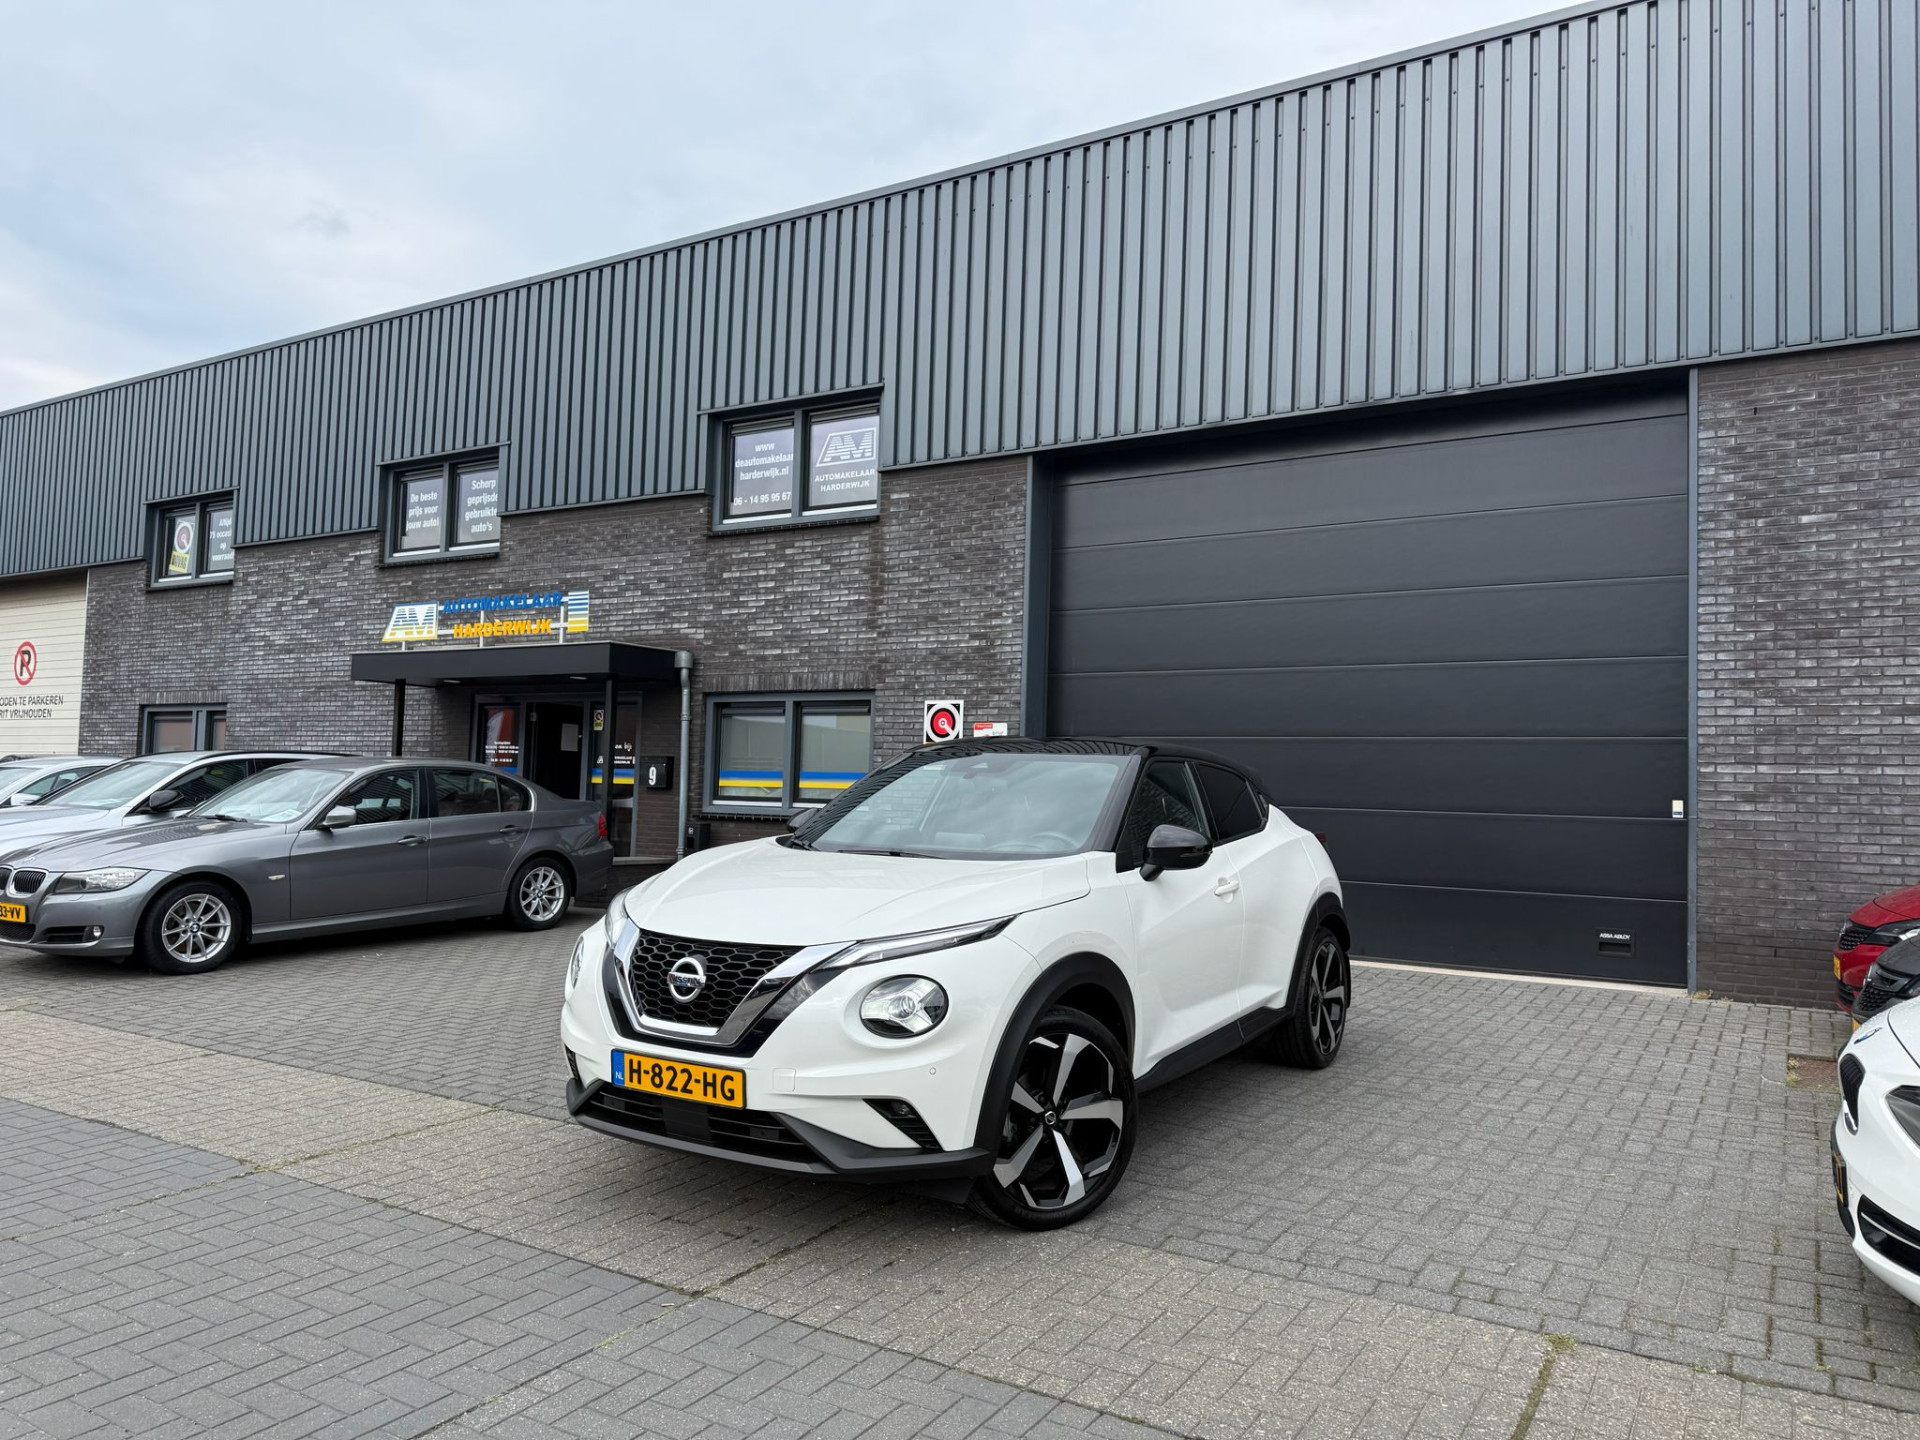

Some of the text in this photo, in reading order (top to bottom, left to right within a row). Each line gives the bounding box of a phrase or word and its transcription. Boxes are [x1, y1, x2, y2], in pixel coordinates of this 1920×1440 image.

[755, 443, 776, 452] www
[740, 466, 789, 480] harderwijk.nl
[814, 469, 876, 482] AUTOMAKELAAR
[471, 480, 496, 490] Scherp
[820, 480, 870, 492] HARDERWIJK
[410, 490, 438, 503] De beste
[734, 496, 743, 506] 06
[750, 495, 759, 505] 14
[760, 493, 770, 503] 95
[771, 492, 780, 502] 95
[782, 491, 791, 501] 67
[408, 505, 439, 518] prijs voor
[471, 521, 493, 533] auto's
[441, 591, 563, 615] AUTOMAKELAAR
[453, 618, 552, 638] HARDERWIJK
[19, 695, 27, 706] TE
[28, 694, 64, 706] PARKEREN
[648, 766, 657, 786] 9
[668, 973, 703, 988] NISSAN
[615, 1071, 624, 1080] NL
[628, 1058, 735, 1101] H-822-HG
